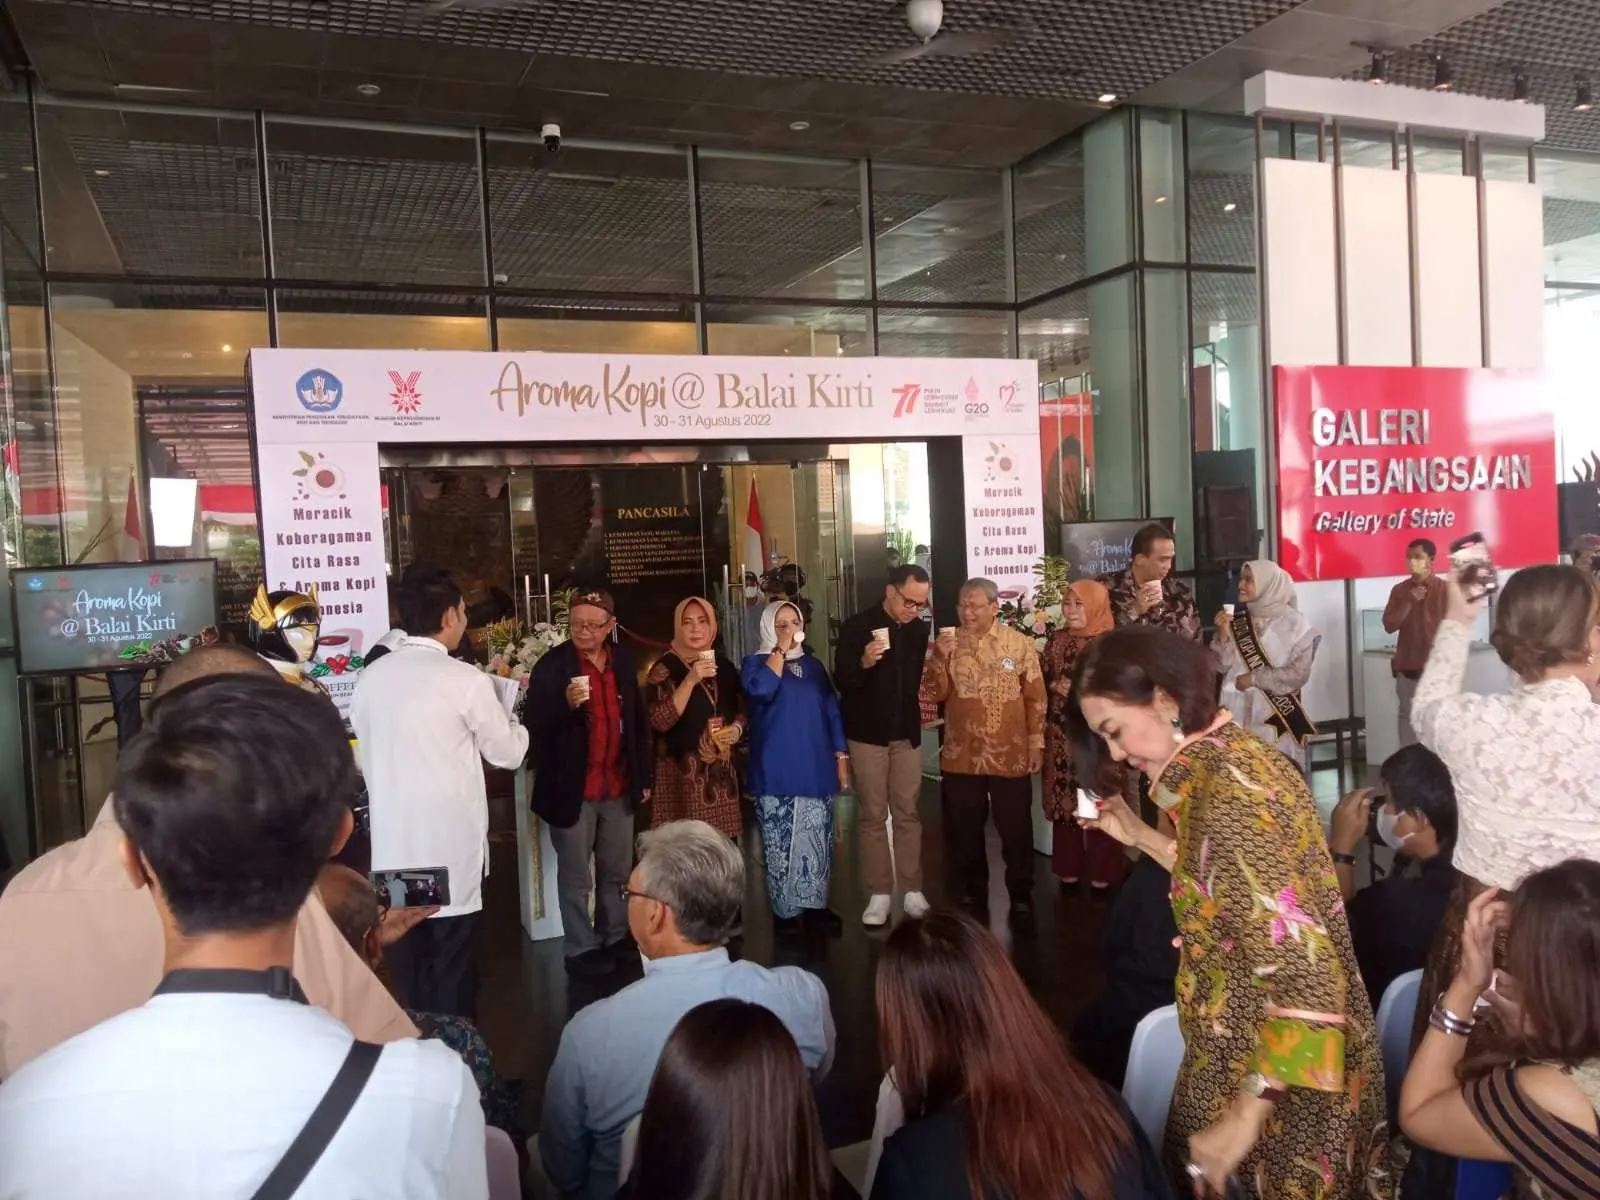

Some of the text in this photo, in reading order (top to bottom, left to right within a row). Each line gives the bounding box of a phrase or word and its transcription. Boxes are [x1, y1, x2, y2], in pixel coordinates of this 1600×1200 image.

[490, 360, 874, 427] Aroma Kopi @ Balai Kirti
[964, 402, 990, 414] G20
[653, 415, 669, 427] 30
[678, 415, 693, 427] 31
[695, 415, 741, 429] Agustus
[743, 414, 772, 426] 2022
[1313, 407, 1431, 447] GALERI
[1314, 454, 1532, 497] KEBANGSAAN
[984, 487, 1022, 498] Meracik
[293, 506, 352, 520] Meracik
[617, 506, 690, 519] PANCASILA
[1315, 507, 1456, 535] Gallery of State
[276, 531, 372, 546] Keberagaman
[982, 526, 1002, 537] Cita
[984, 546, 1014, 556] Aroma
[1017, 544, 1037, 556] Kopi
[292, 555, 360, 569] Cita Rasa
[984, 564, 1028, 576] Indonesia
[346, 577, 375, 591] Kopi
[73, 587, 162, 615] Aroma Kopi
[61, 612, 177, 637] @ Balai Kirti
